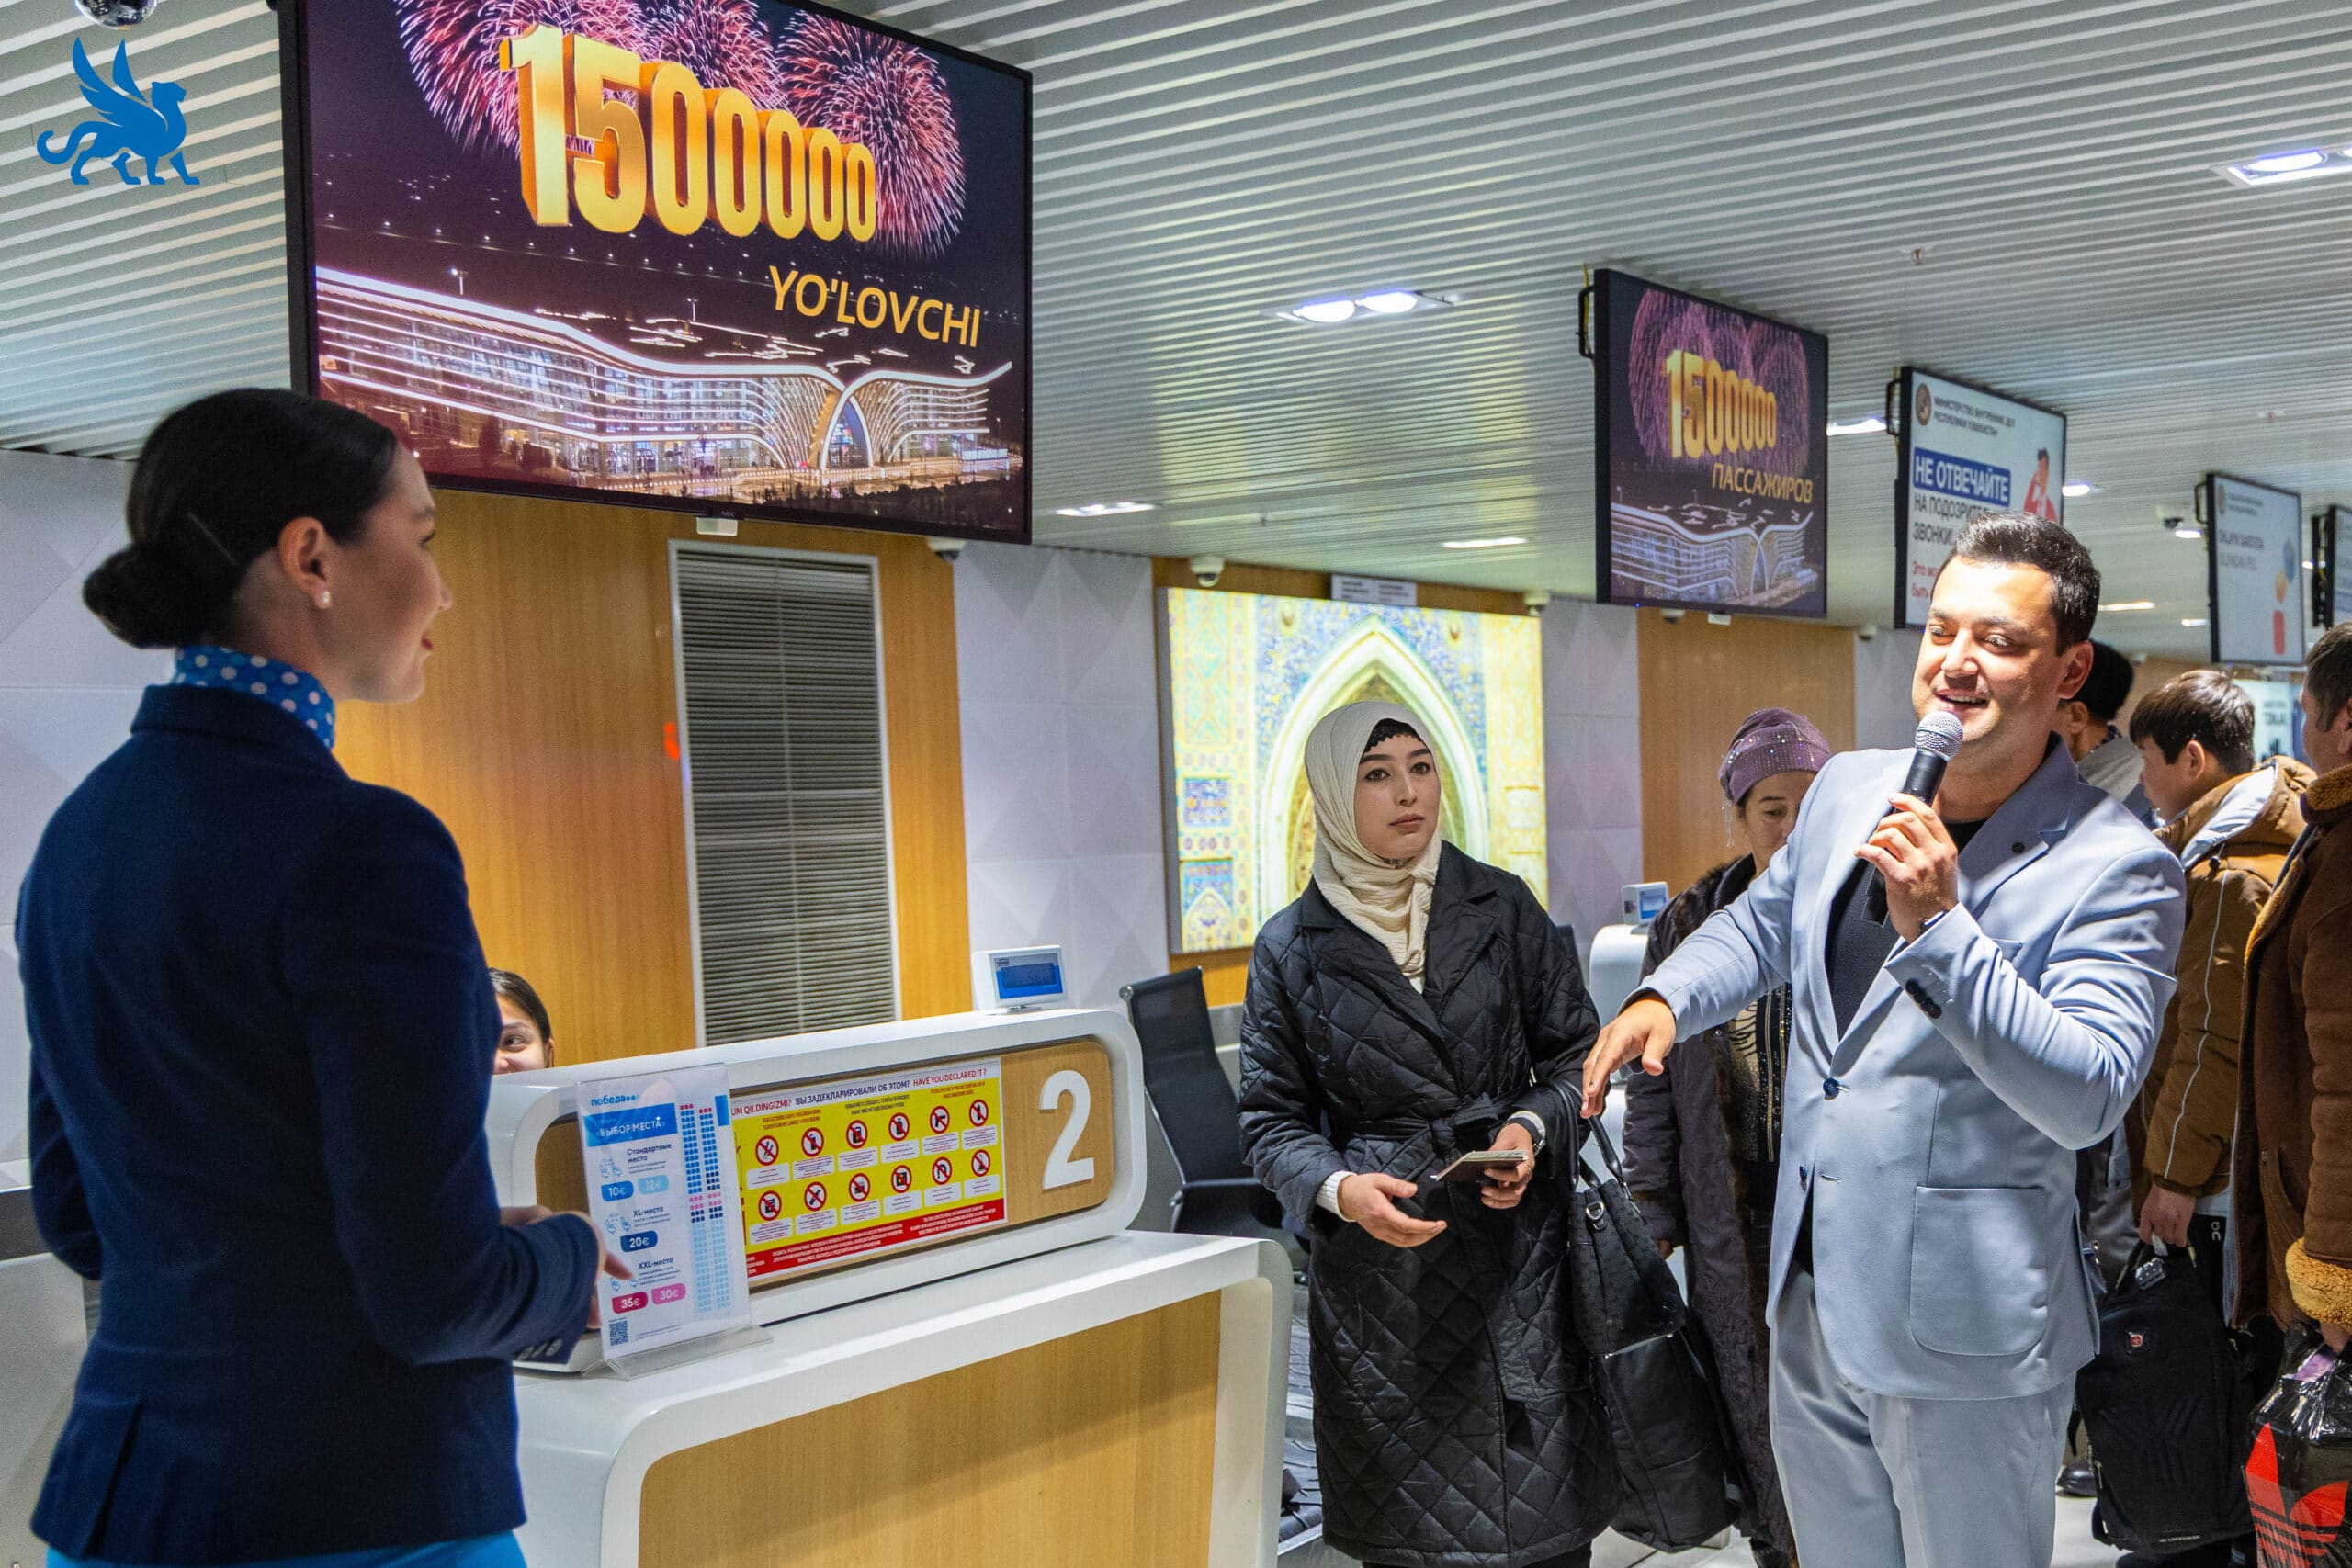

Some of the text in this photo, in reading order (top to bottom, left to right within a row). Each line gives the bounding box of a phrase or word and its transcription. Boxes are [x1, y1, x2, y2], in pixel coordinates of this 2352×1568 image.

[500, 22, 877, 243] 1500000
[769, 265, 980, 347] YO'LOVCHI
[1662, 349, 1778, 458] 1500000
[1712, 462, 1813, 503] ПАССАЖИРОВ
[1915, 456, 2009, 502] НЕ ОТВЕЧАЙТЕ
[1914, 492, 1927, 512] НА
[913, 1077, 930, 1087] HAVE
[931, 1074, 944, 1083] YOU
[944, 1070, 976, 1082] DECLARED
[591, 1094, 626, 1107] победа
[796, 1080, 910, 1105] ВЫ ЗАДЕКЛАРИРОВАЛИ ОБ ЭТОМ?
[731, 1107, 742, 1116] UM
[1039, 1070, 1094, 1190] 2
[627, 1143, 673, 1156] Стандартные
[608, 1186, 627, 1197] 10€
[629, 1237, 650, 1248] 20€
[621, 1297, 640, 1309] 35€
[660, 1289, 678, 1301] 30€
